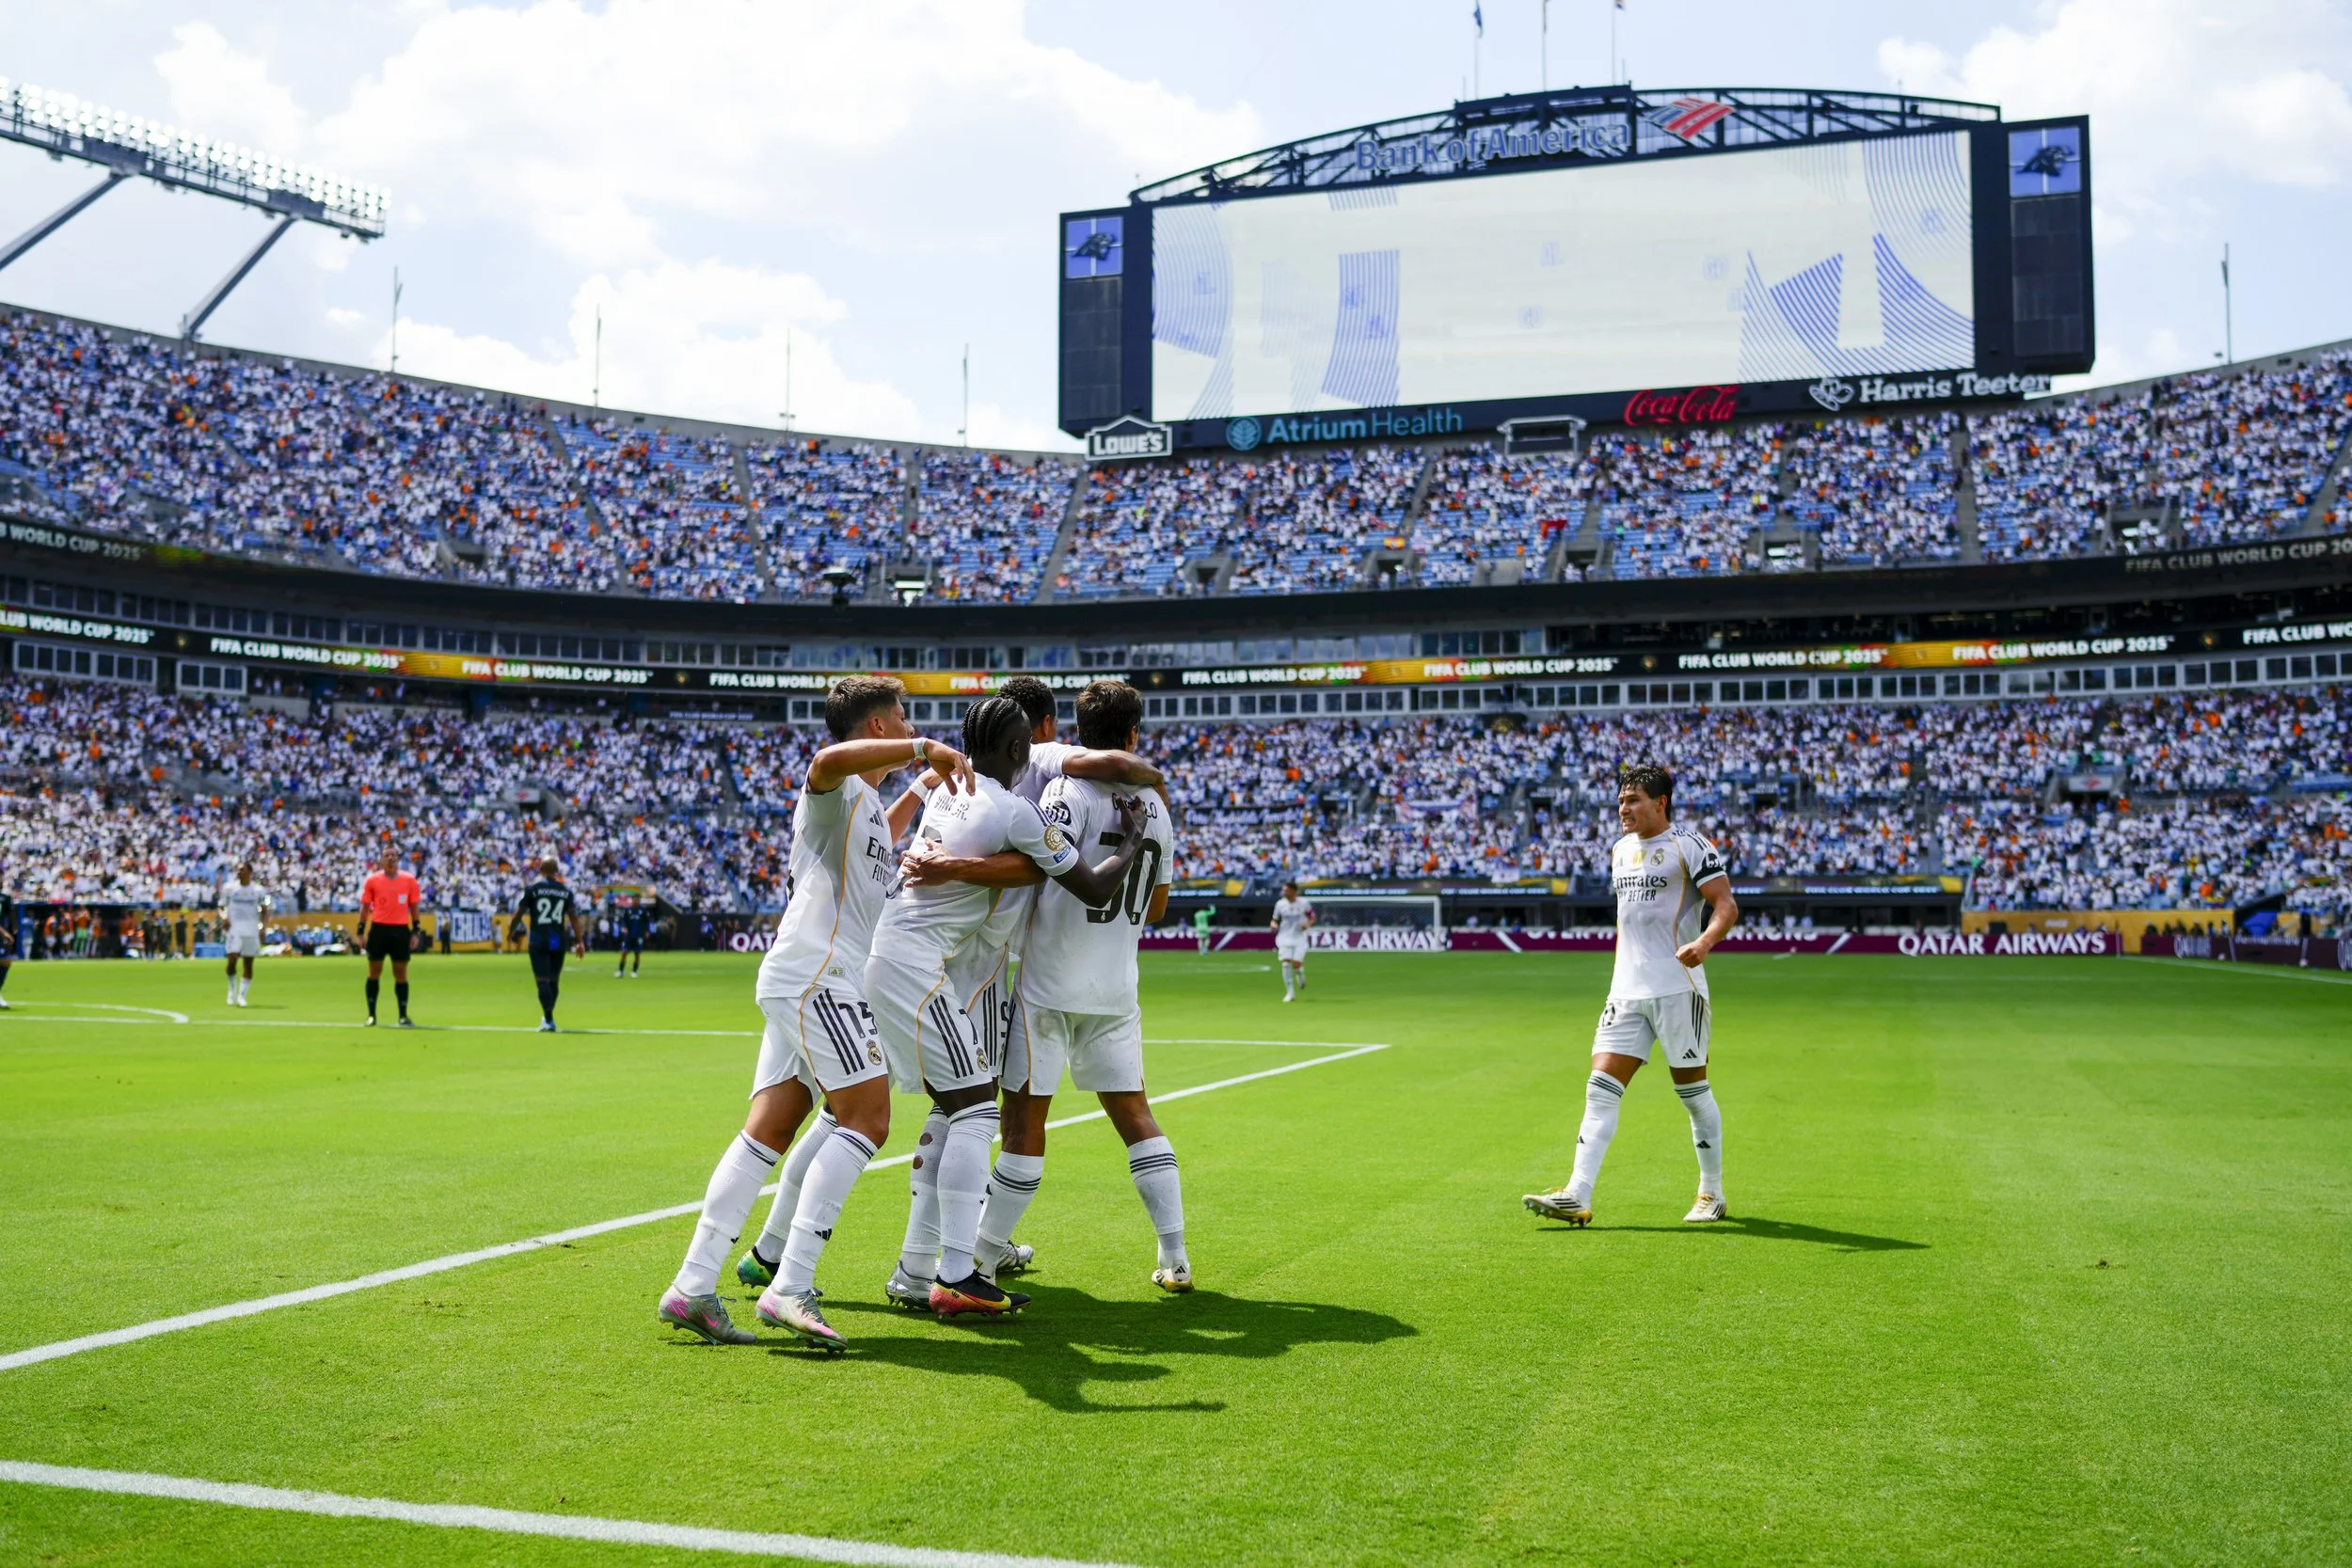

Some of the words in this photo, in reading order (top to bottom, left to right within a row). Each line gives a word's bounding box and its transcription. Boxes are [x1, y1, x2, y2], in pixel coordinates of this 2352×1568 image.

[1355, 134, 1439, 169] Bank
[1447, 129, 1479, 163] of
[1484, 119, 1629, 159] America
[1859, 377, 1951, 403] Harris
[1956, 372, 2050, 396] Teeter
[1267, 417, 1366, 443] Atrium
[1372, 407, 1463, 436] Health
[1093, 431, 1163, 455] LOWE'S
[9, 524, 67, 548] WORLD
[69, 535, 99, 553] CUP
[2125, 560, 2164, 573] FIFA
[2168, 554, 2213, 570] CLUB
[2217, 546, 2284, 565] WORLD
[2288, 542, 2328, 559] CUP
[29, 614, 82, 636] WORLD
[83, 621, 113, 639] CUP
[2243, 627, 2279, 644] FIFA
[2280, 625, 2326, 641] CLUB
[211, 638, 242, 654] FIFA
[243, 641, 279, 658] CLUB
[281, 645, 331, 662] WORLD
[332, 651, 362, 666] CUP
[1678, 655, 1710, 669] FIFA
[1711, 653, 1750, 668] CLUB
[1752, 651, 1805, 667] WORLD
[1808, 649, 1841, 665] CUP
[1952, 646, 1986, 660] FIFA
[1987, 643, 2028, 659] CLUB
[2030, 641, 2090, 657] WORLD
[2090, 639, 2124, 654] CUP
[462, 661, 490, 675] FIFA
[494, 663, 530, 678] CLUB
[532, 665, 581, 681] WORLD
[583, 668, 612, 682] CUP
[1182, 671, 1211, 685] FIFA
[1212, 669, 1248, 684] CLUB
[1248, 668, 1298, 682] WORLD
[1298, 667, 1327, 681] CUP
[1423, 663, 1454, 677] FIFA
[1454, 661, 1491, 676] CLUB
[1492, 660, 1545, 674] WORLD
[1546, 659, 1575, 673] CUP
[709, 673, 739, 687] FIFA
[740, 673, 776, 688] CLUB
[777, 674, 826, 689] WORLD
[950, 676, 978, 689] FIFA
[1614, 874, 1667, 889] mirates
[537, 897, 564, 924] 24
[1899, 934, 1985, 956] QATAR
[1994, 932, 2106, 955] AIRWAYS
